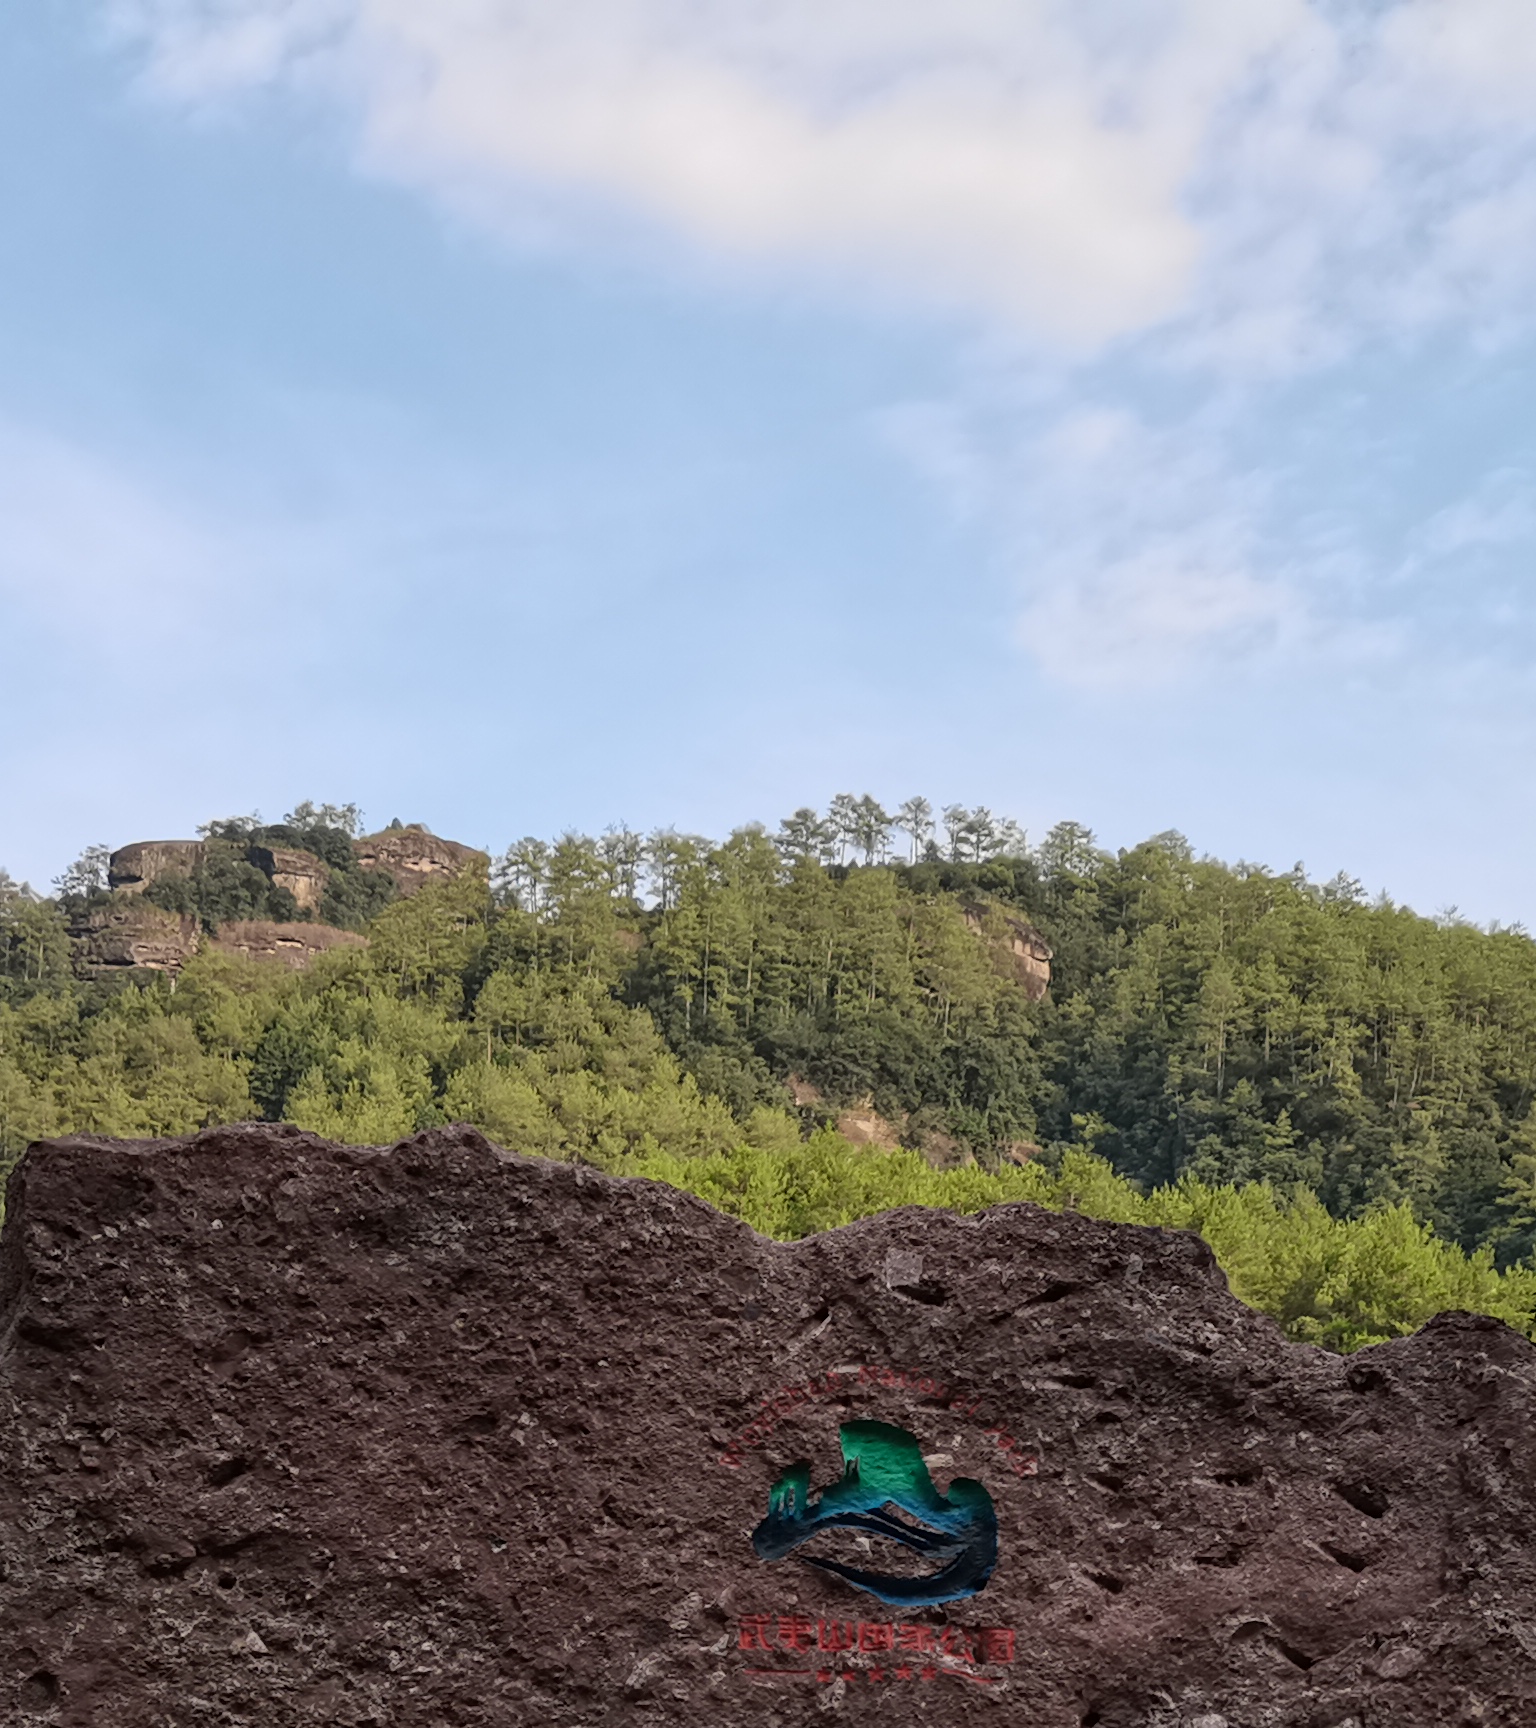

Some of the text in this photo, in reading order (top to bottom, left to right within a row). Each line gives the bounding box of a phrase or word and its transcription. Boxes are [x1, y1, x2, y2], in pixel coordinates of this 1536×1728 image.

[738, 1613, 1015, 1665] 武夷山国家公园
